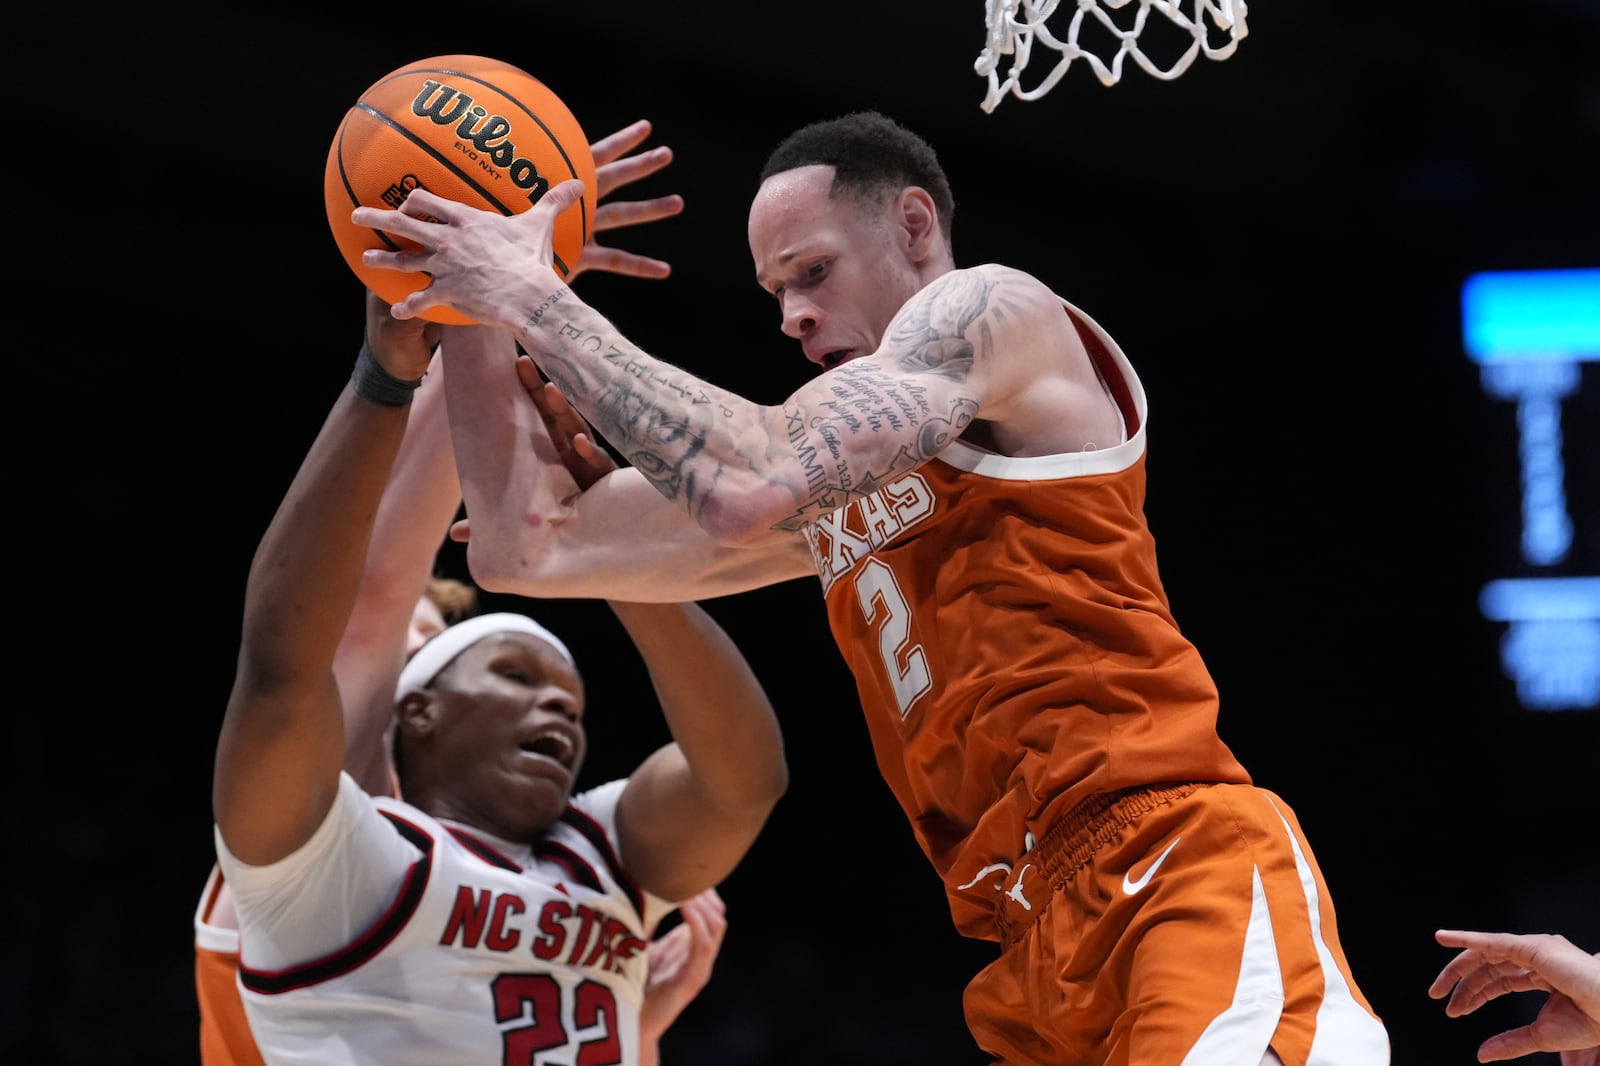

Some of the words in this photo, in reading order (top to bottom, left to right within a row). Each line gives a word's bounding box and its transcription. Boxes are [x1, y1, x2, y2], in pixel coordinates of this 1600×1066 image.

[453, 141, 478, 162] EVO
[478, 160, 503, 180] NXT
[559, 321, 734, 419] PATIENCE
[866, 414, 883, 434] in
[871, 406, 904, 433] you
[801, 471, 937, 601] EXAS
[853, 554, 933, 721] 2
[438, 884, 527, 953] NC
[490, 972, 622, 1066] 22
